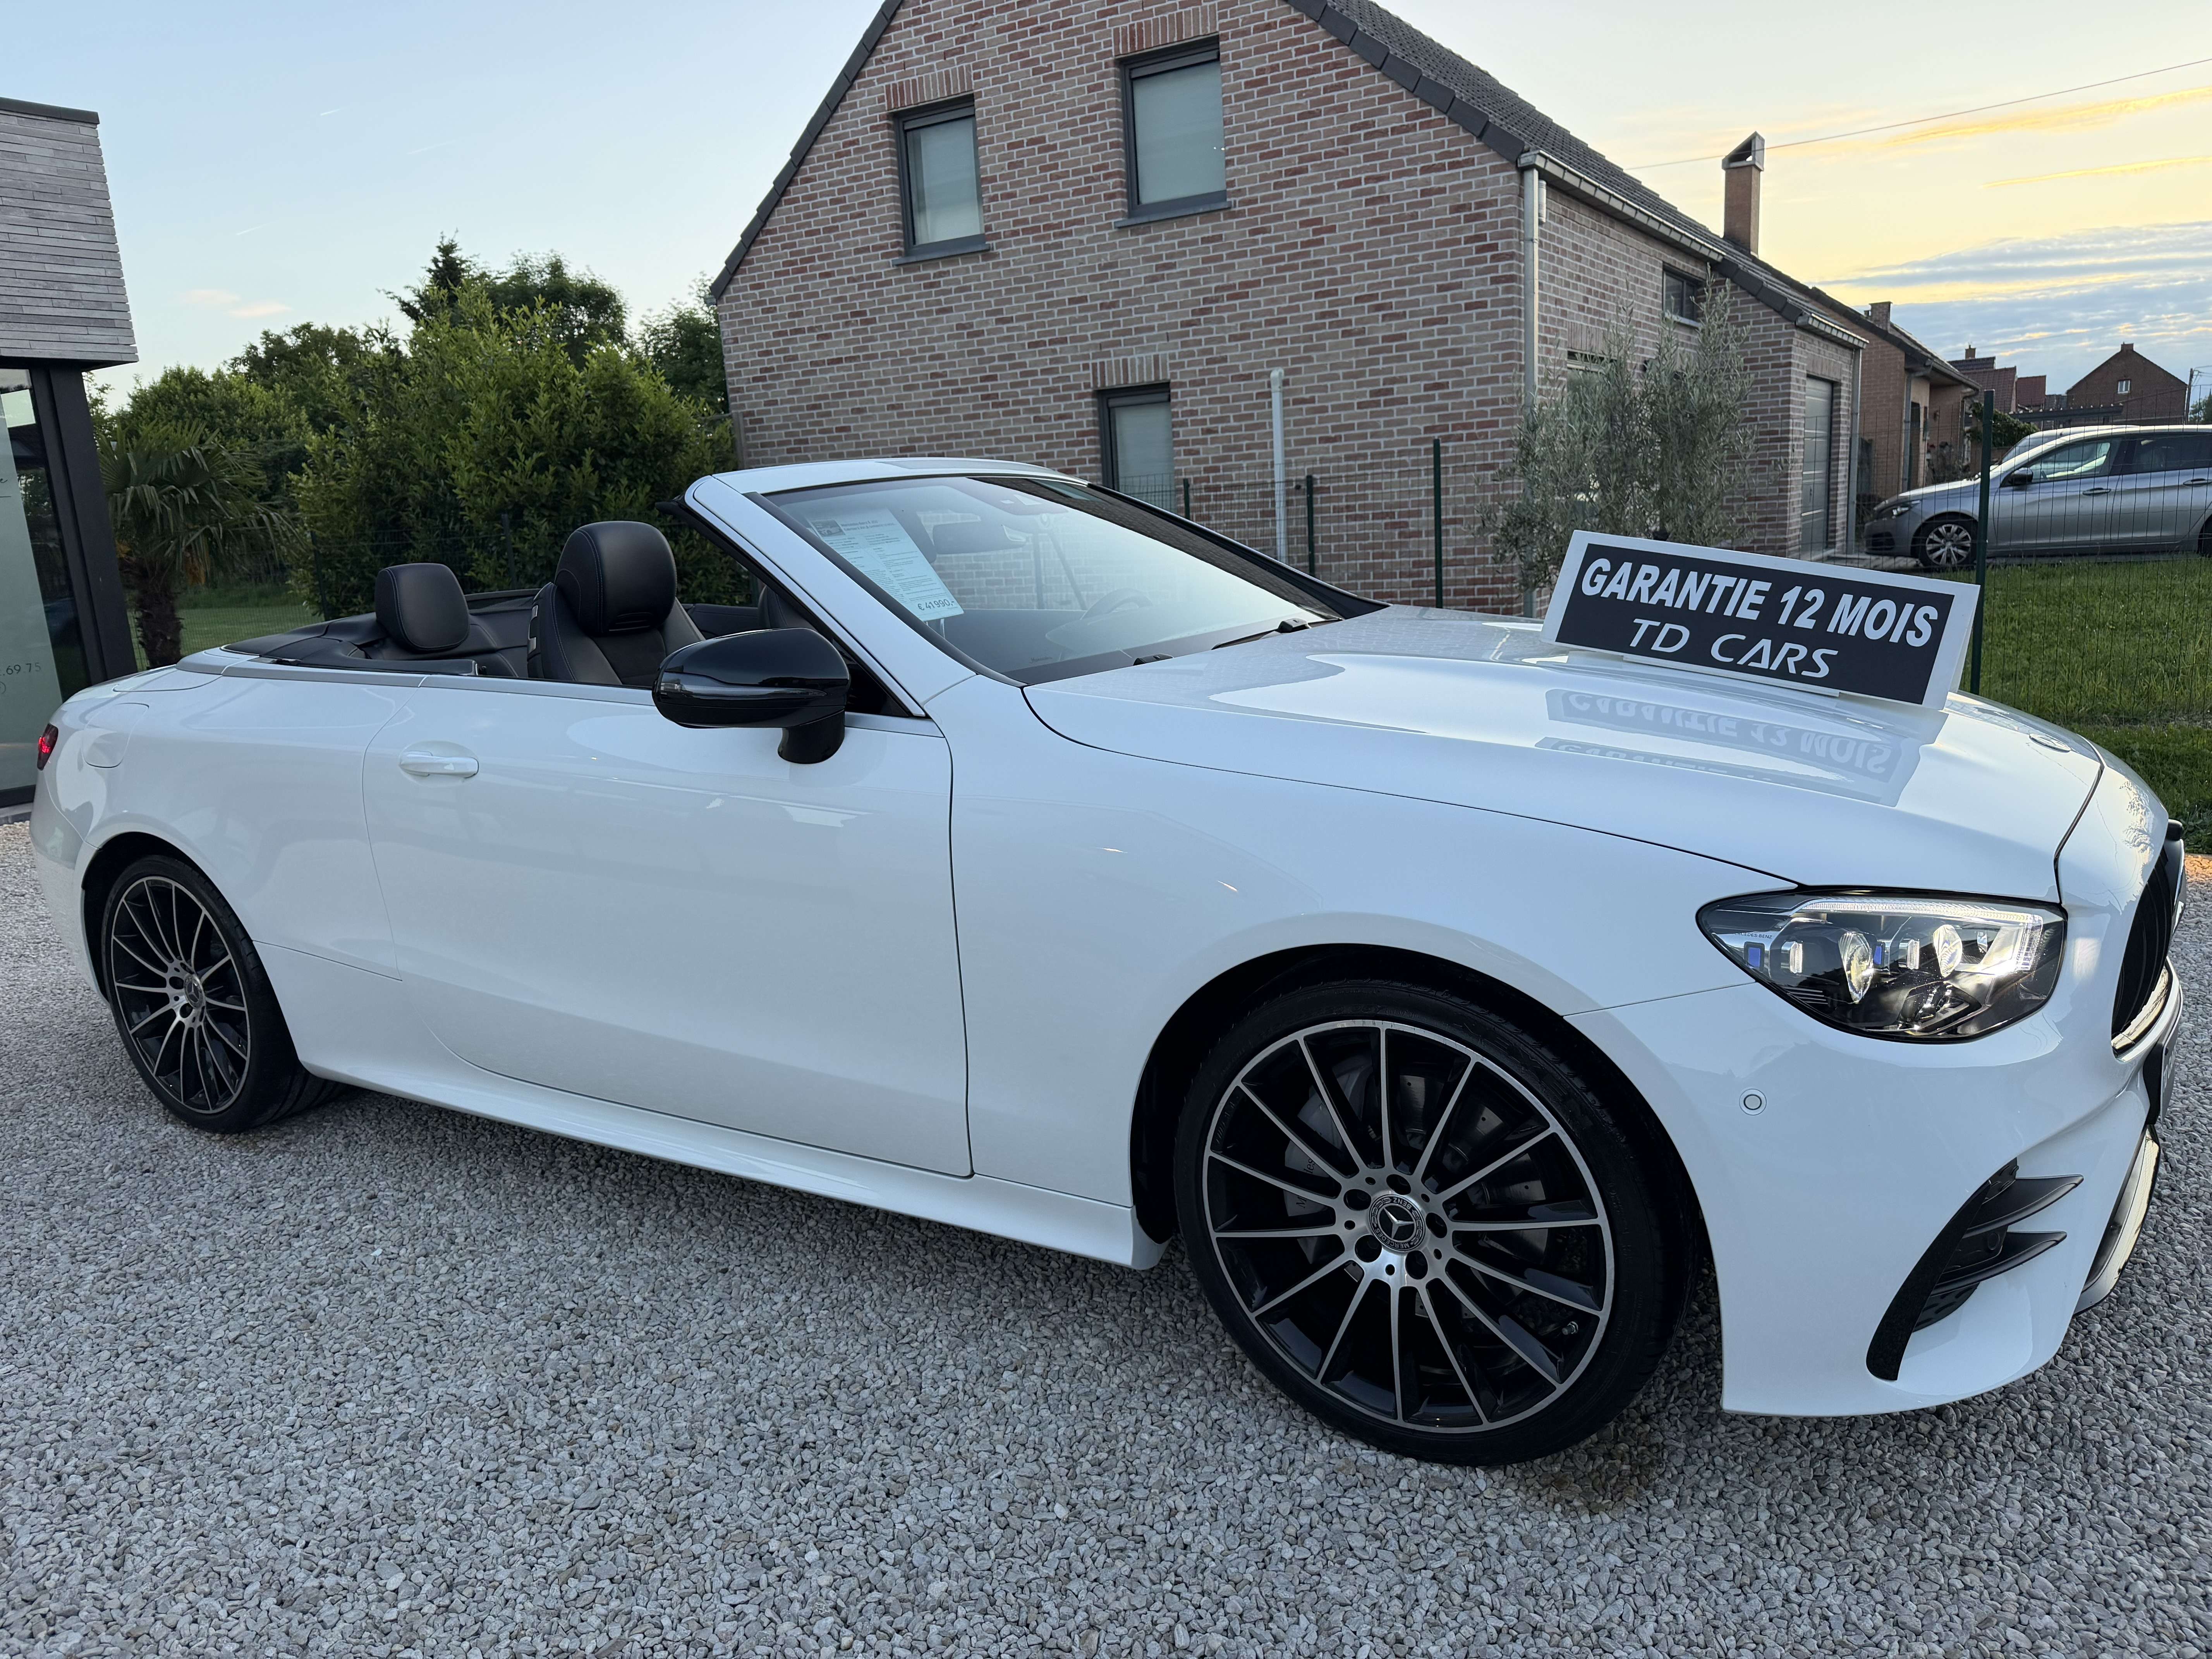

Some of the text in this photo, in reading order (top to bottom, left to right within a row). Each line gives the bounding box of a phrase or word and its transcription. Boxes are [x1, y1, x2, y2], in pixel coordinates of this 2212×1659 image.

[1582, 558, 1938, 647] GARANTIE 12 MOIS
[1630, 618, 1838, 678] TD CARS
[1393, 1197, 1412, 1211] BENZ
[1375, 1227, 1410, 1249] MERCEDES
